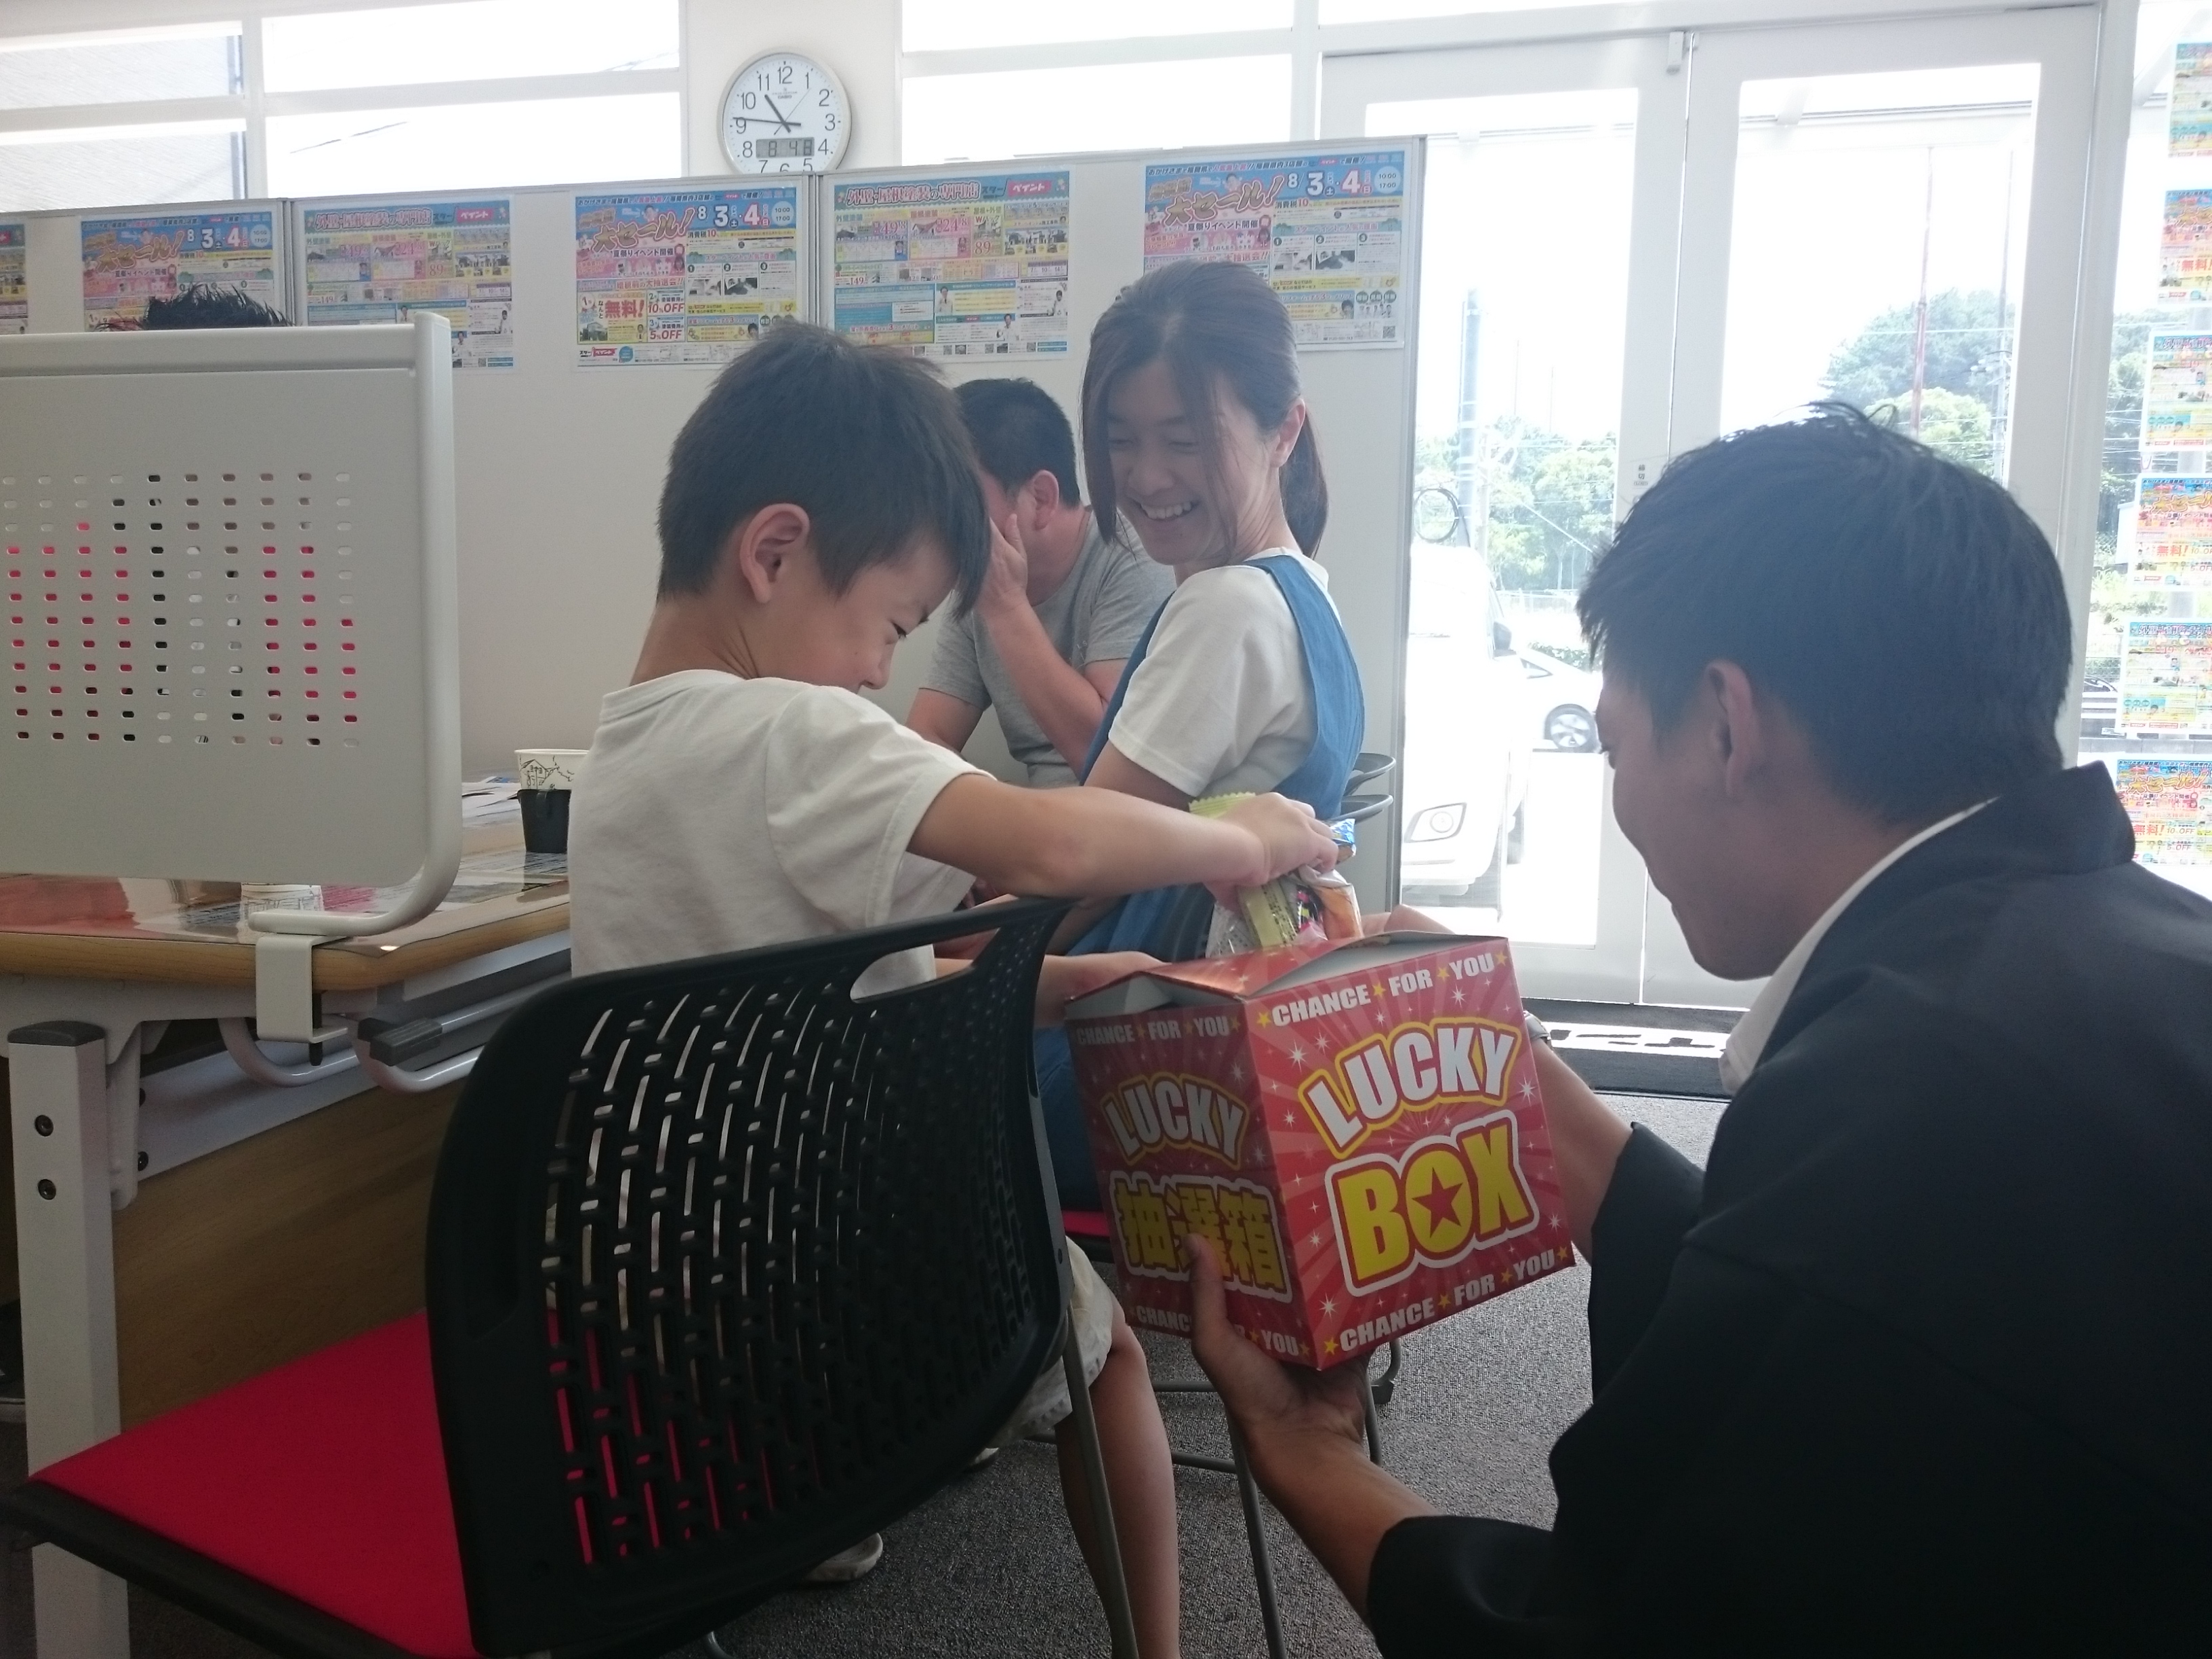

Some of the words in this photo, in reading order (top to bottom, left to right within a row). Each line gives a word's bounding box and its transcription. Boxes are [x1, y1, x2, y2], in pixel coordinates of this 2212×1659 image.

[758, 73, 769, 91] 11
[777, 66, 793, 84] 12
[805, 72, 810, 89] 1
[741, 91, 756, 110] 10
[819, 89, 830, 106] 2
[735, 117, 747, 134] 9
[824, 113, 836, 131] 3
[742, 140, 753, 158] 8
[768, 141, 777, 157] 8
[817, 138, 829, 155] 4
[758, 159, 769, 173] 7
[803, 158, 813, 171] 5
[1012, 183, 1045, 192] ペイント
[1307, 171, 1324, 196] 3
[1342, 169, 1361, 194] 4
[714, 205, 729, 227] 3
[743, 203, 760, 226] 4
[201, 228, 214, 249] 3
[226, 227, 241, 248] 4
[605, 299, 644, 319] 無料!
[1271, 985, 1370, 1027] CHANCE
[1388, 969, 1433, 997] FOR
[1450, 952, 1495, 980] YOU
[1078, 1023, 1136, 1045] CHANCE
[1148, 1020, 1182, 1041] FOR
[1193, 1015, 1231, 1038] YOU
[1304, 1025, 1518, 1151] LUCKY
[1103, 1079, 1245, 1163] LUCKY
[1335, 1118, 1532, 1282] BOX
[1340, 1297, 1435, 1352] CHANCE
[1454, 1274, 1496, 1306] FOR
[1513, 1248, 1556, 1282] YOU
[1136, 1305, 1192, 1333] CHANC
[1260, 1330, 1300, 1357] YOU
